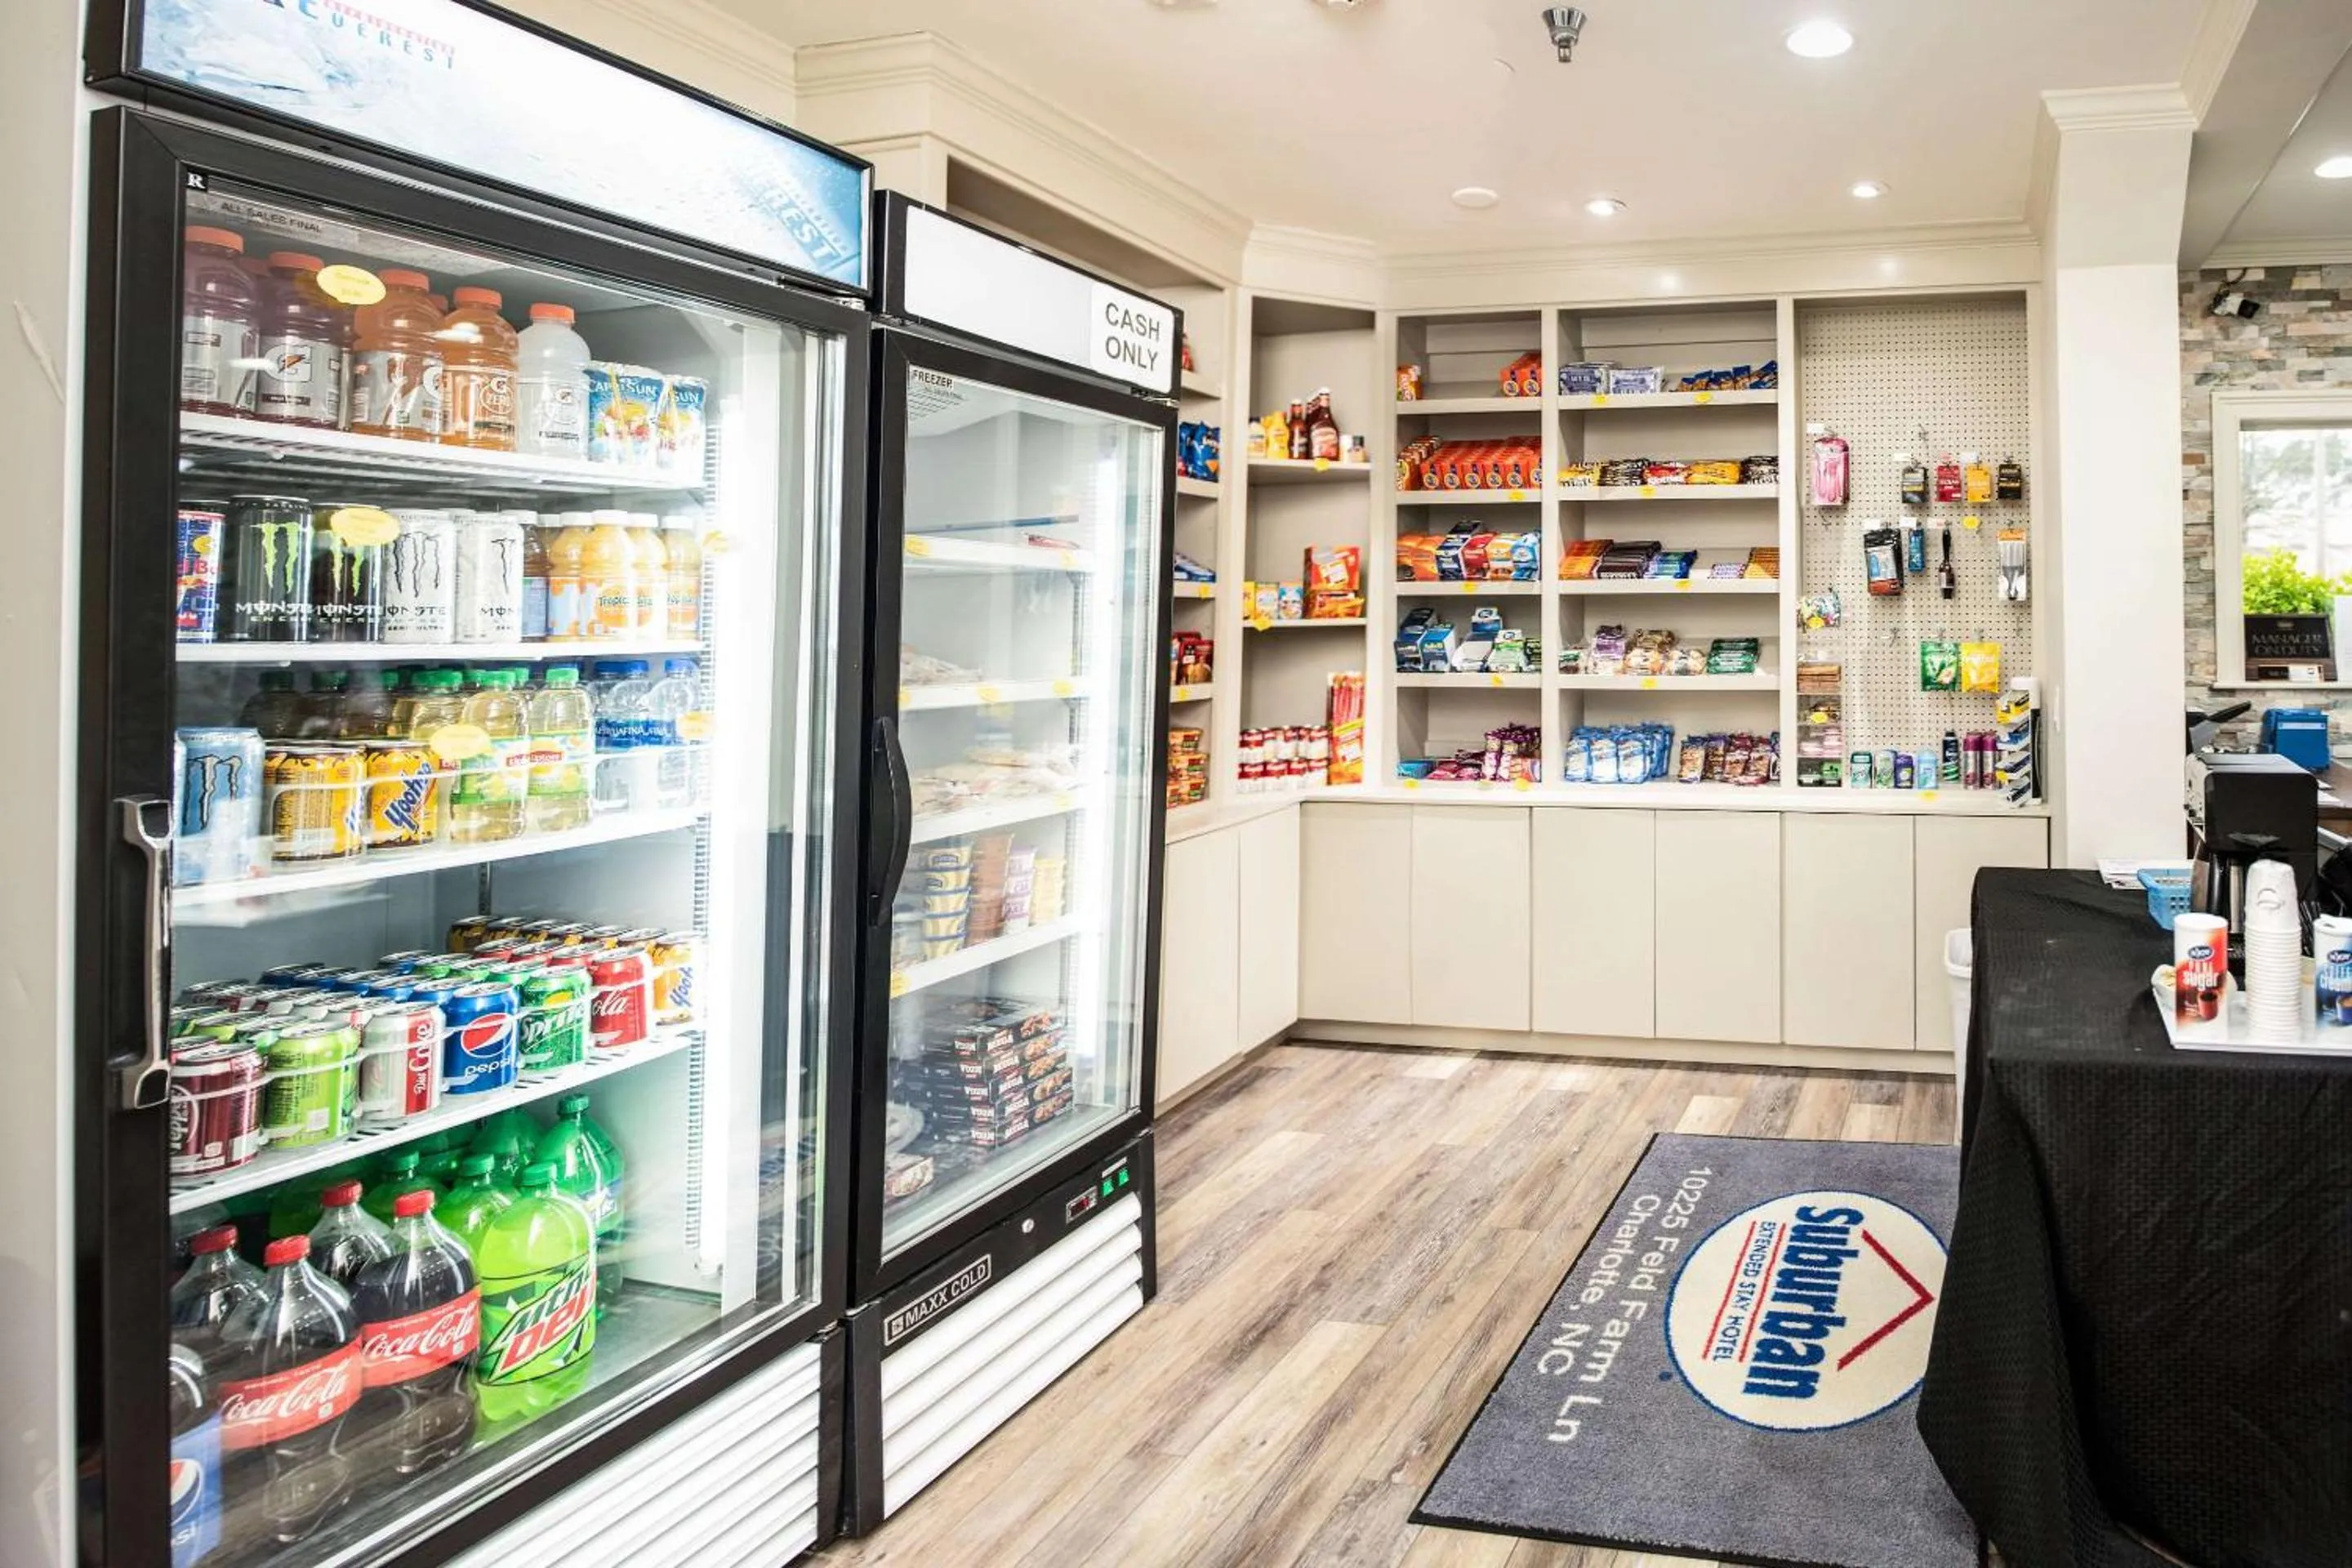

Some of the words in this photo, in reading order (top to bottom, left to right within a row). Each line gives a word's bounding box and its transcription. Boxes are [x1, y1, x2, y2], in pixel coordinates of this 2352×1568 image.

[221, 202, 241, 214] ALL
[247, 207, 287, 225] SALES
[289, 218, 322, 233] FINAL
[1105, 301, 1160, 342] CASH
[1105, 336, 1158, 372] ONLY
[626, 382, 657, 398] SUN
[672, 391, 700, 403] SUN
[2182, 970, 2220, 991] sugar
[1664, 1166, 1713, 1230] 10225
[1570, 1194, 1659, 1311] Charlotte,
[1630, 1236, 1680, 1292] Feld
[1744, 1221, 1776, 1277] EXTENDED
[905, 1290, 947, 1327] MAXX
[951, 1263, 987, 1298] COLD
[1731, 1281, 1757, 1312] STAY
[1741, 1205, 1864, 1399] Suburban
[363, 1298, 478, 1360] Coca-Cola
[1537, 1321, 1592, 1375] NC
[1579, 1300, 1648, 1383] Farm
[1713, 1315, 1744, 1361] HOTEL
[220, 1356, 351, 1423] Coca-Cola
[1547, 1394, 1602, 1442] Ln
